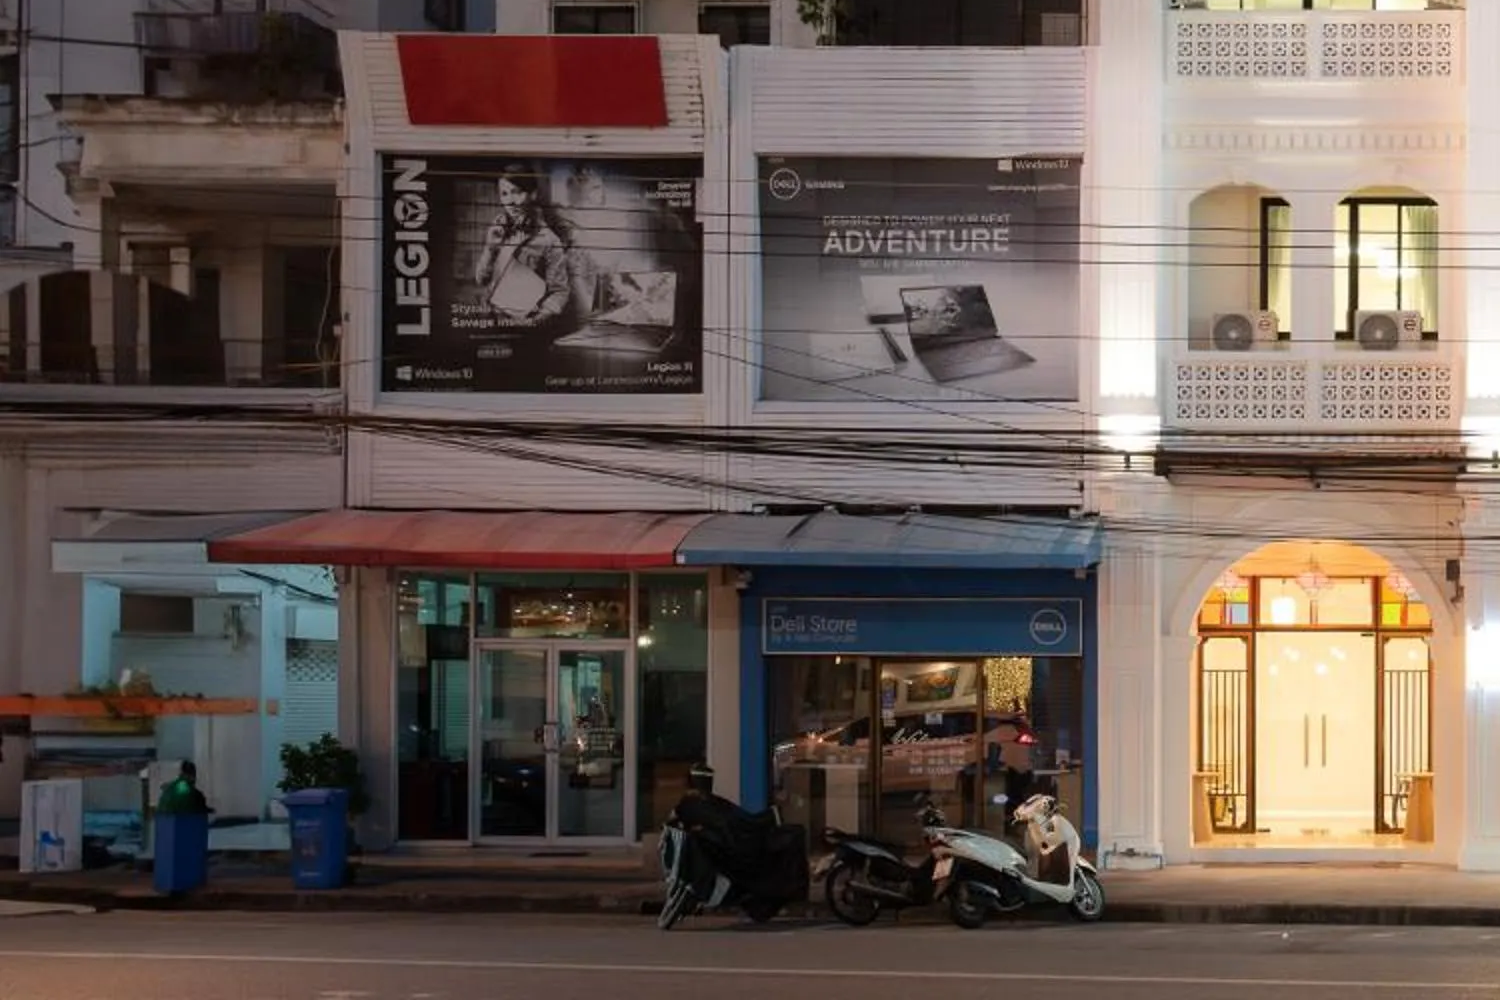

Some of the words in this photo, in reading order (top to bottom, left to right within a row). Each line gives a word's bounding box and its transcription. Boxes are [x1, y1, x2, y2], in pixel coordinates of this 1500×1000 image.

[394, 160, 430, 335] LEGION
[823, 229, 1009, 254] ADVENTURE
[415, 368, 461, 379] Windows
[771, 615, 806, 632] Dell
[810, 615, 857, 633] Store
